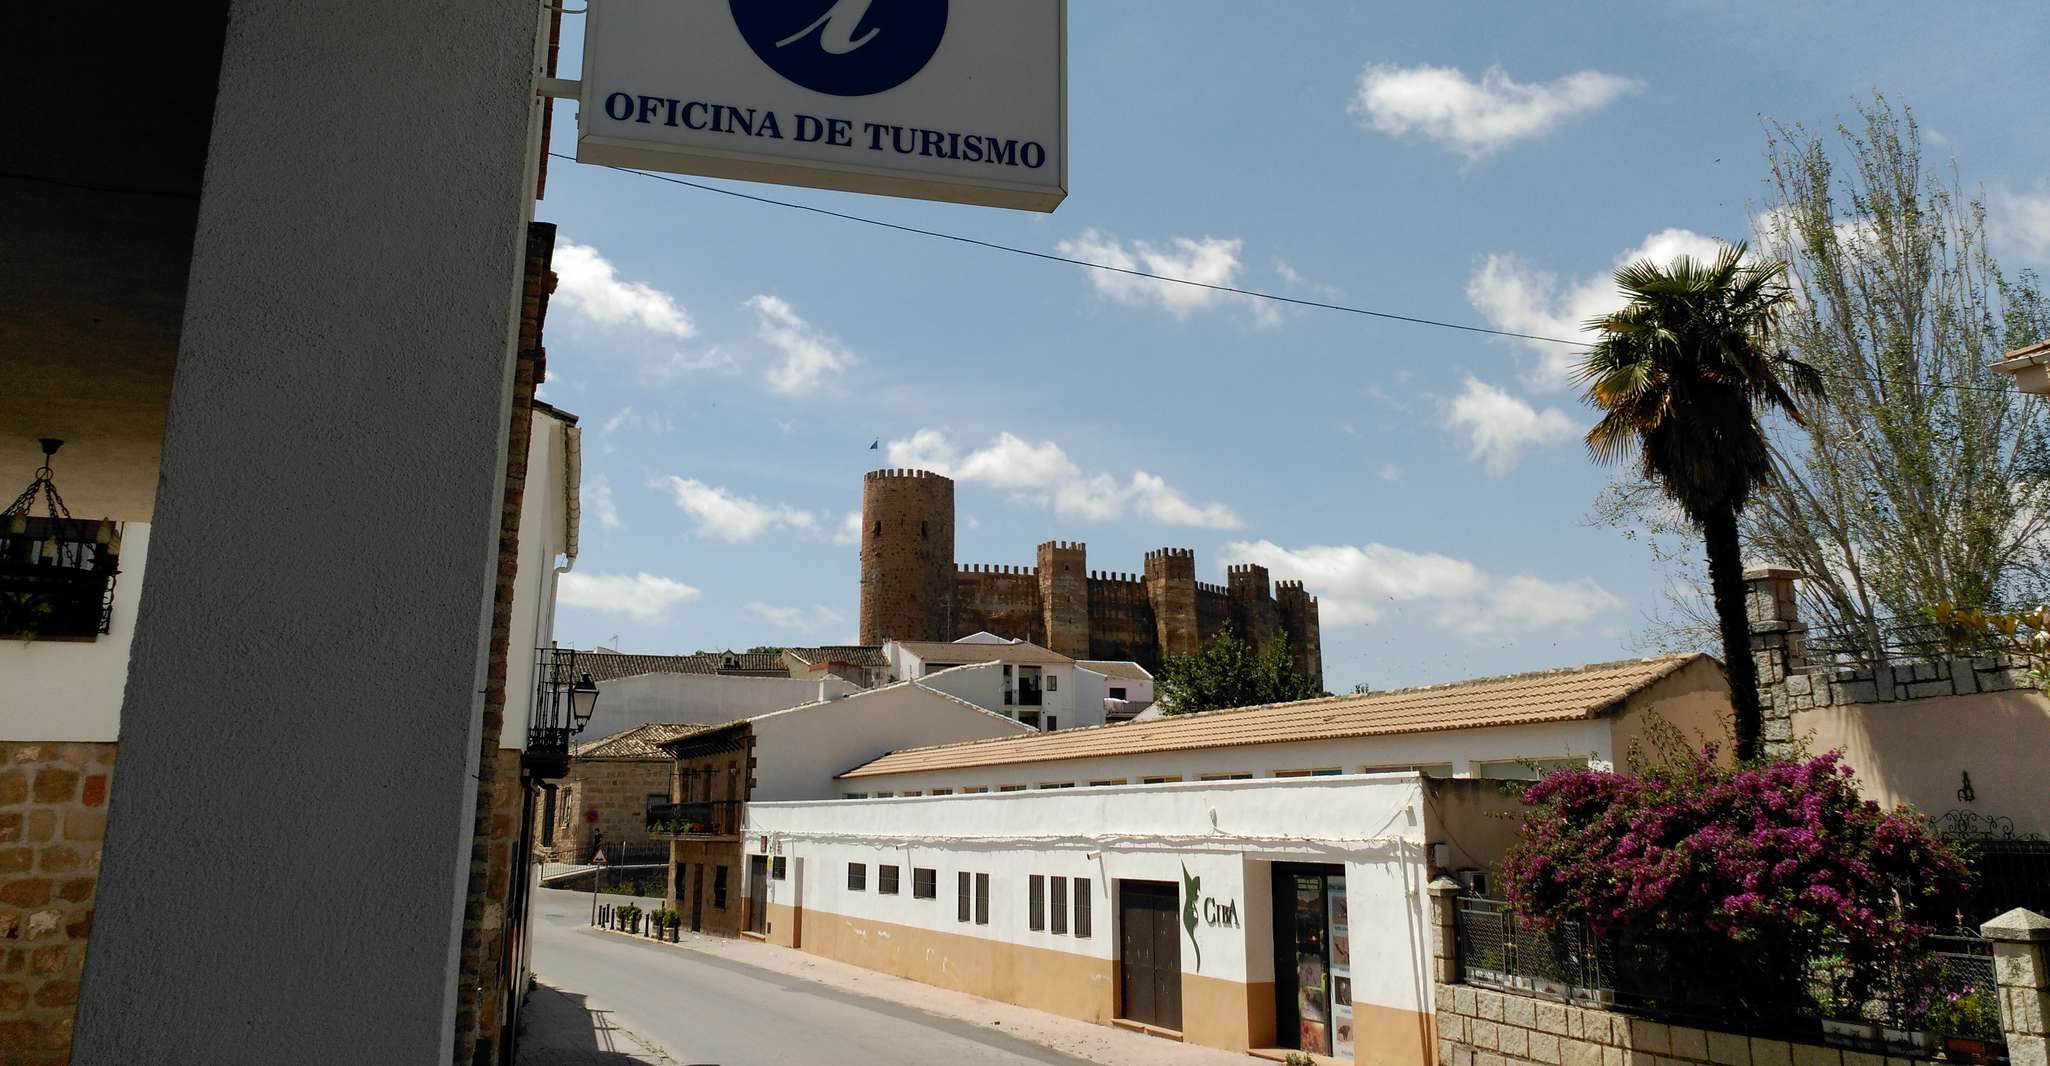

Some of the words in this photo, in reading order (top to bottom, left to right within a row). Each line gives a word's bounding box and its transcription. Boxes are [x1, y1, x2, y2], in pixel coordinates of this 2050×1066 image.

[605, 92, 783, 139] OFICINA
[794, 114, 853, 147] DE
[864, 122, 1046, 169] TURISMO
